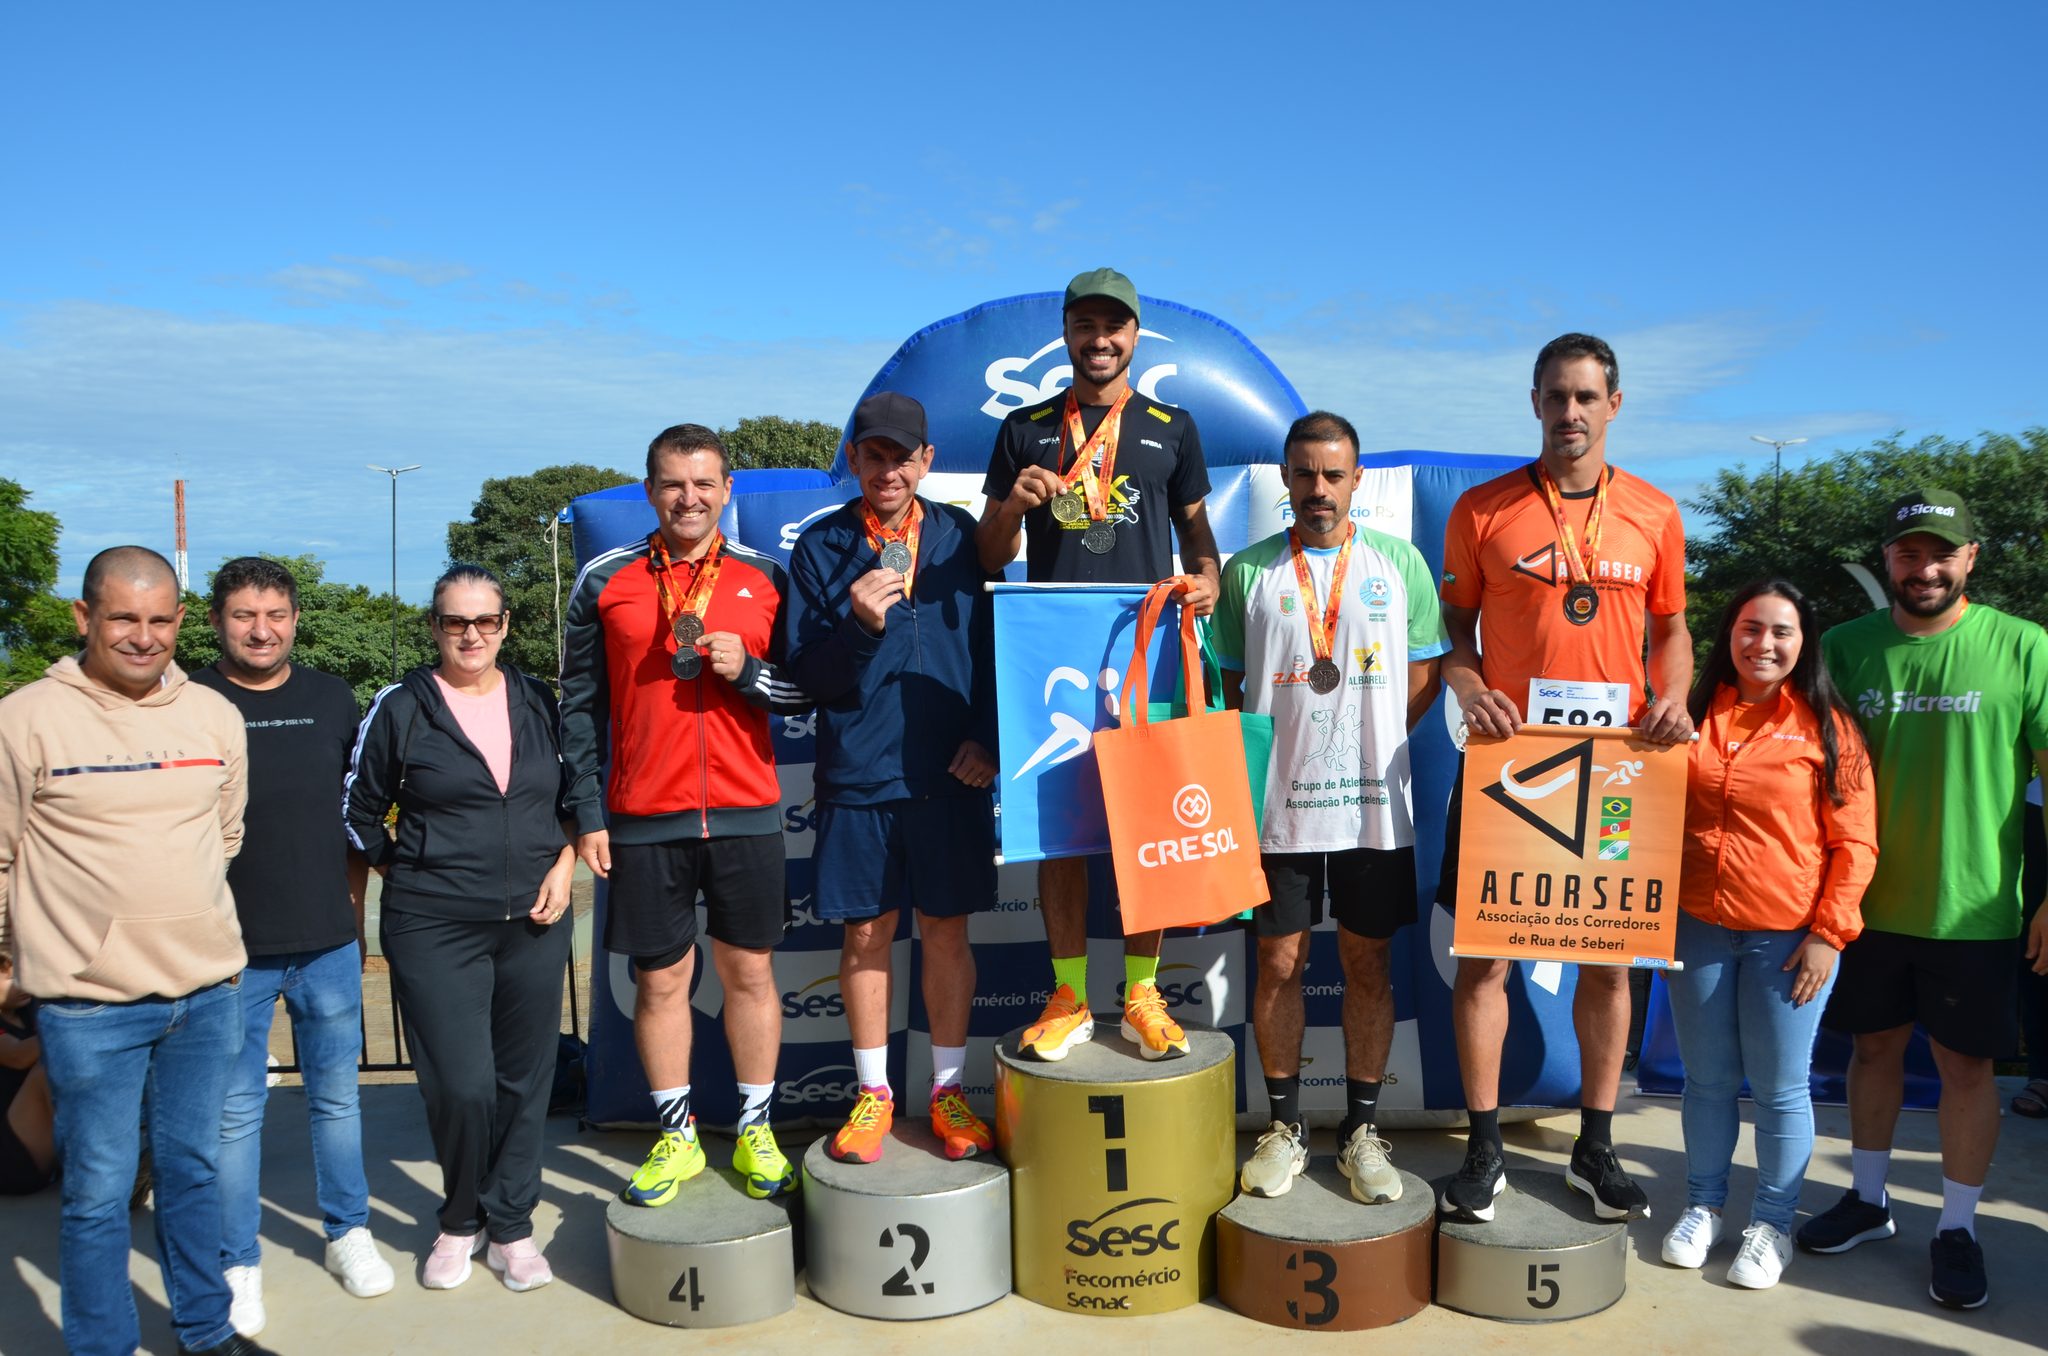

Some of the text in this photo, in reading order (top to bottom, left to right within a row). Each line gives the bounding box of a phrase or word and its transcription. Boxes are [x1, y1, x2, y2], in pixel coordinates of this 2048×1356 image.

[1375, 506, 1394, 518] RS
[1909, 503, 1956, 518] Sicredi
[1558, 560, 1642, 583] ARSEB
[1890, 691, 1983, 713] Sicredi
[106, 750, 185, 764] PARIS
[1291, 776, 1384, 794] Grupo de Atletismo
[1285, 794, 1390, 810] Associação Portelense
[1137, 827, 1239, 868] CRESOL
[1480, 870, 1663, 913] ACORSEB
[1476, 909, 1660, 931] Associação dos Corredores
[1509, 932, 1625, 951] de Rua de Seberi
[782, 991, 845, 1018] Ses
[1088, 1095, 1128, 1192] 1
[879, 1223, 934, 1297] 2
[1065, 1267, 1180, 1288] Fecomércio
[1286, 1250, 1340, 1326] 3
[1526, 1263, 1560, 1310] 5
[668, 1267, 705, 1312] 4
[1067, 1291, 1129, 1310] Senac
